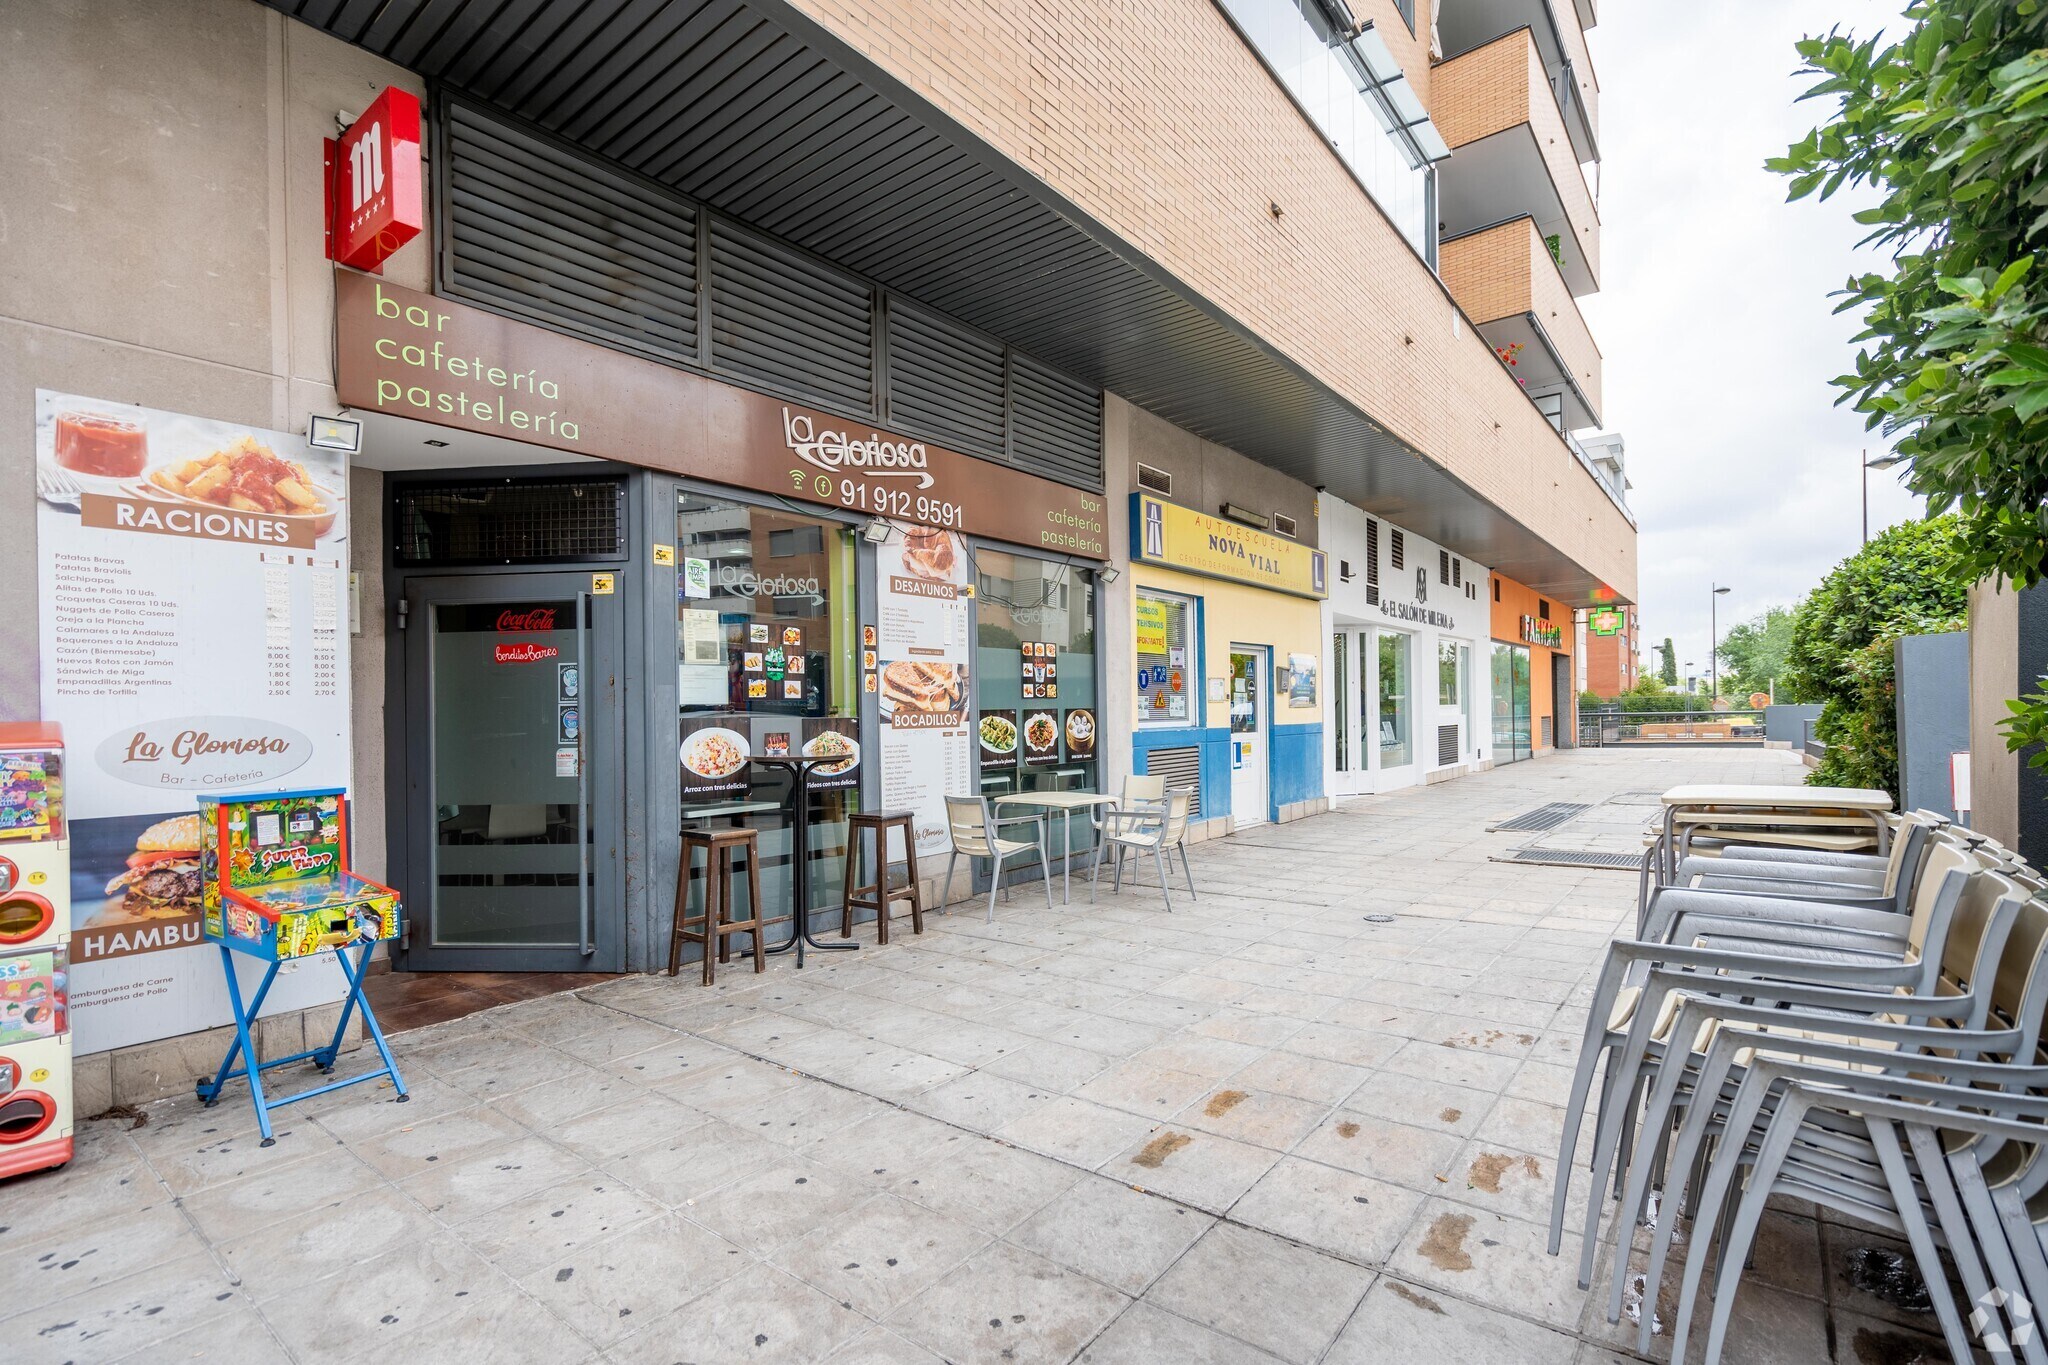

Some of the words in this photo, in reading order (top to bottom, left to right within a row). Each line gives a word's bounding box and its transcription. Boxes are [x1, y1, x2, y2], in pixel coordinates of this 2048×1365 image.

[376, 283, 450, 331] bar
[376, 338, 559, 399] cafetería
[378, 377, 579, 440] pastelería
[817, 431, 927, 468] Gloriosa
[840, 479, 866, 509] 91
[874, 486, 911, 517] 912
[916, 496, 962, 528] 9591
[1081, 493, 1100, 512] bar
[117, 503, 289, 542] RACIONES
[1048, 509, 1100, 532] cafetería
[1042, 531, 1101, 553] pastelería
[1195, 516, 1290, 554] AUTOESCUELA
[55, 553, 90, 562] Patatas
[94, 556, 125, 565] Bravas
[1179, 553, 1207, 567] CENTRO
[1209, 534, 1245, 558] NOVA
[1249, 553, 1280, 574] VIAL
[55, 564, 91, 572] Patatas
[94, 566, 132, 575] Braviolis
[56, 574, 115, 584] Salchipapas
[740, 573, 819, 596] Gloriosa
[895, 580, 953, 597] DESAYUNOS
[56, 595, 106, 604] Croquetas
[109, 598, 146, 606] Caseras
[56, 605, 96, 614] Nuggets
[56, 616, 83, 624] Oreja
[107, 618, 145, 626] Plancha
[497, 609, 557, 631] Coca-Cola
[1390, 601, 1397, 617] EL
[1398, 602, 1419, 623] SALÓN
[1420, 610, 1427, 624] DE
[56, 626, 109, 635] Calamares
[133, 629, 175, 637] Andaluza
[1137, 619, 1163, 629] TENSIVOS
[56, 637, 113, 645] Boquerones
[137, 639, 179, 647] Andaluza
[56, 646, 88, 654] Cazón
[57, 678, 121, 686] Empanadillas
[895, 714, 957, 727] BOCADILLOS
[123, 732, 164, 763] La
[172, 730, 289, 765] Gloriosa
[161, 773, 184, 784] Bar
[203, 769, 263, 785] Cafetería
[726, 782, 747, 790] delicias
[84, 922, 199, 957] HAMBU
[71, 985, 130, 999] amburguesa
[147, 977, 173, 986] Carne
[71, 995, 130, 1009] amburguesa
[147, 987, 168, 995] Pollo
